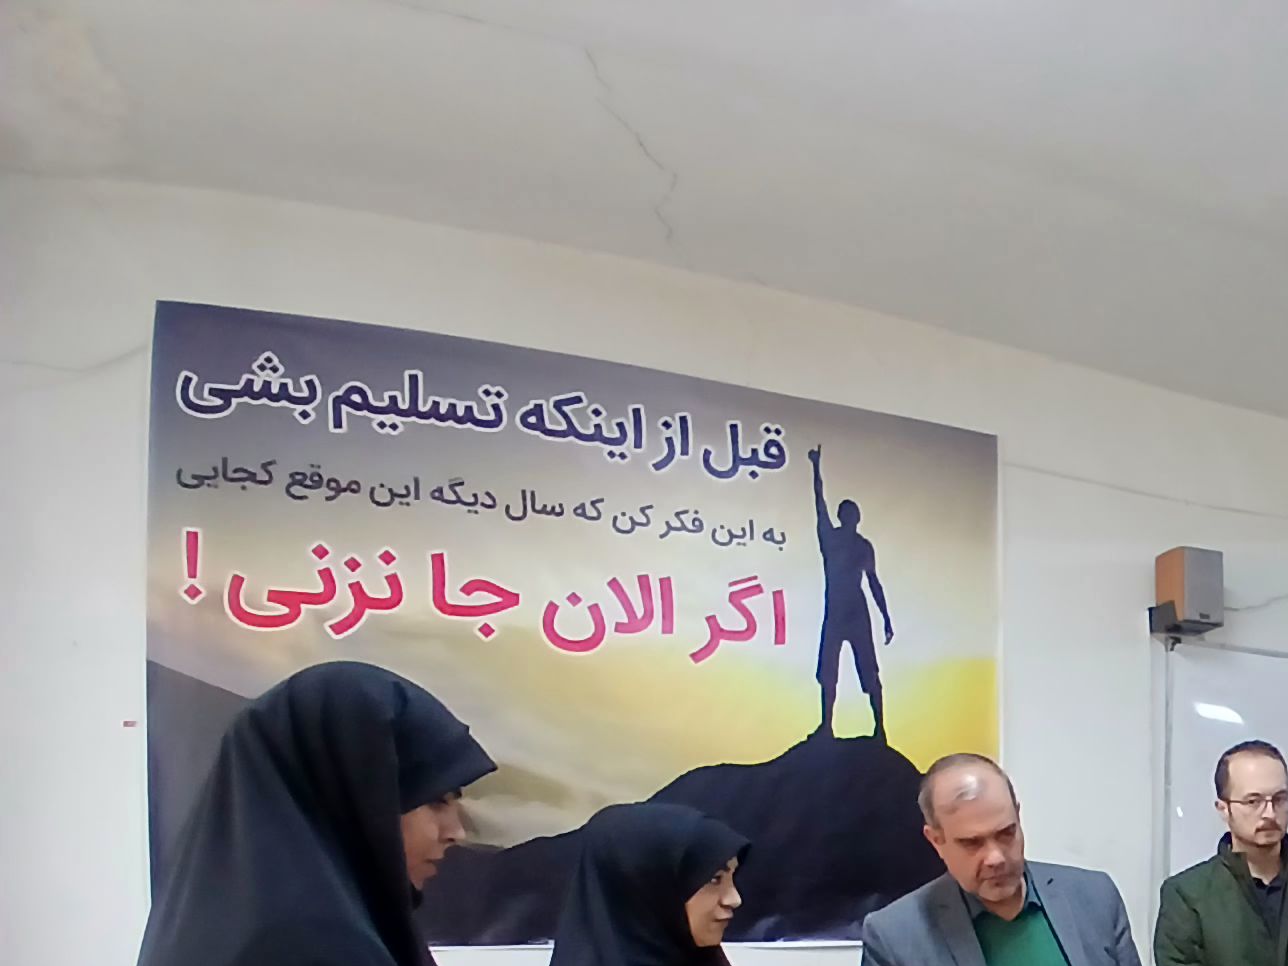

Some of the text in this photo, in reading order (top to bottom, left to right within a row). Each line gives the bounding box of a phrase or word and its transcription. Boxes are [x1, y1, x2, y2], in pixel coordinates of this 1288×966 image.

[179, 354, 788, 481] قبل از اینکه تسلیم بشی
[175, 456, 787, 551] به این فکر کن که سال دیگه این موقع کجایی
[226, 543, 404, 636] نزنی
[430, 551, 521, 639] جا
[541, 573, 675, 653] الان
[688, 574, 787, 664] اگر
